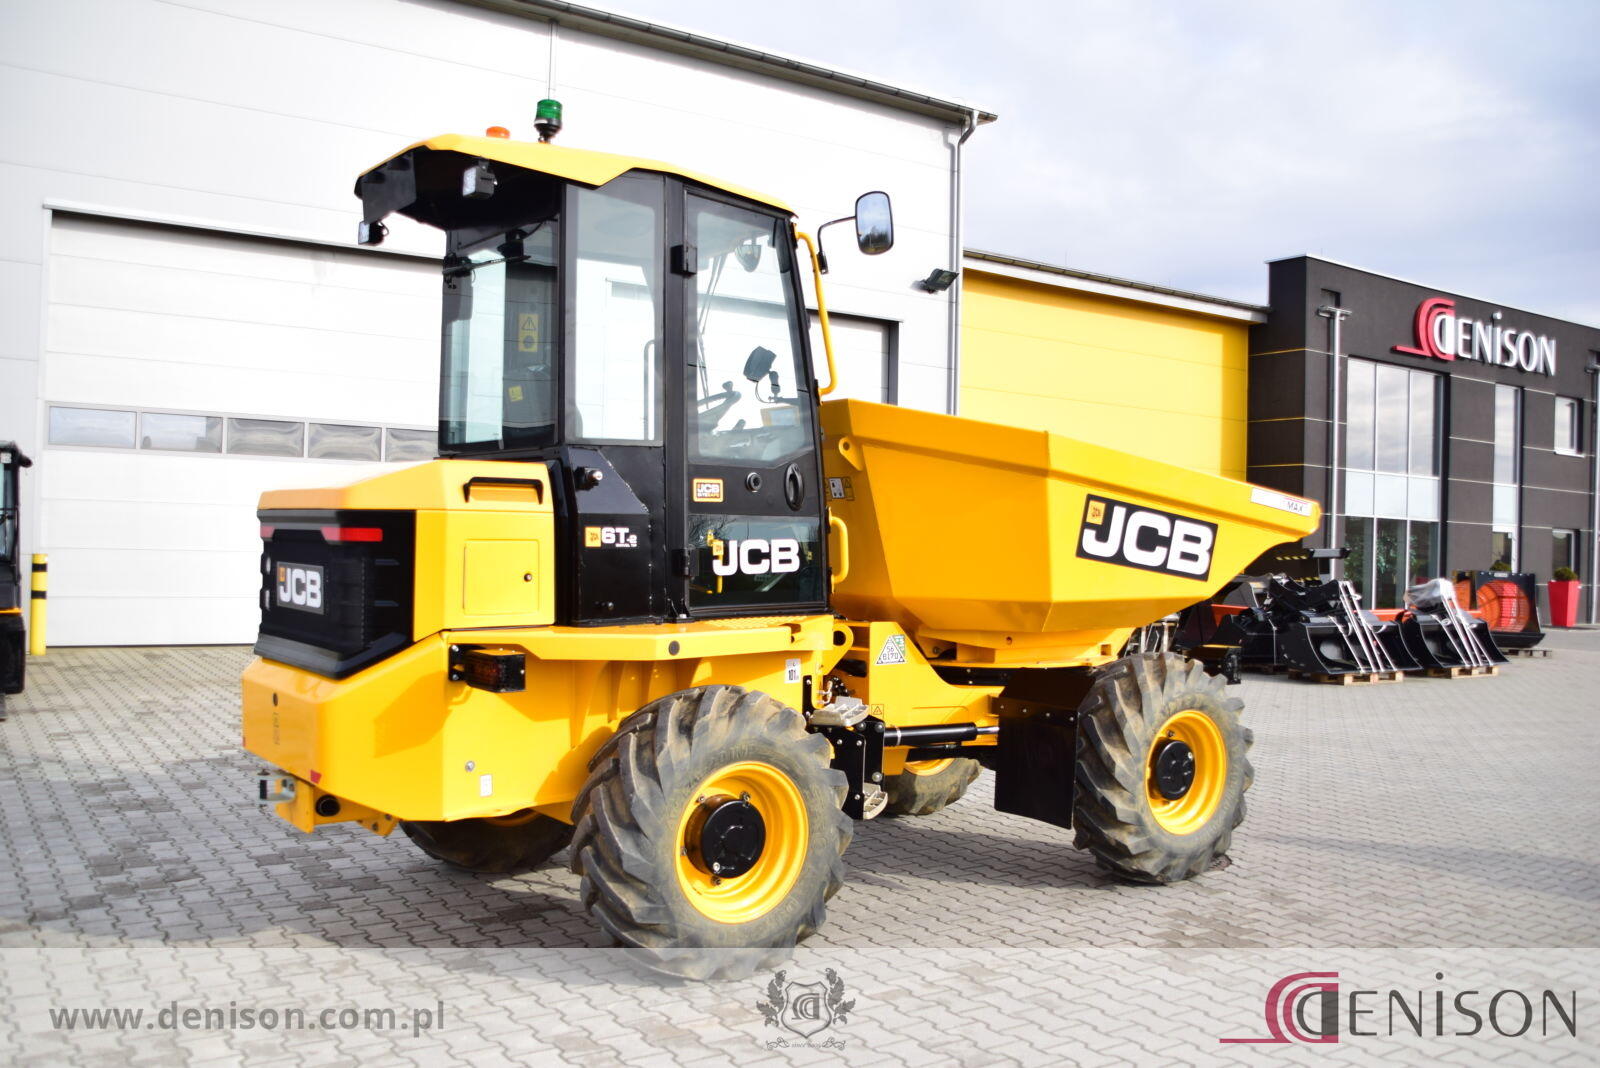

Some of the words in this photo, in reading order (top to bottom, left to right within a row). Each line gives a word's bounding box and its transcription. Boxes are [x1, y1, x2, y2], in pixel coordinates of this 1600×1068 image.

[697, 484, 719, 493] JCB
[1287, 501, 1304, 513] MAX
[712, 538, 800, 576] JCB
[1081, 504, 1214, 576] JCB
[279, 567, 322, 608] JCB
